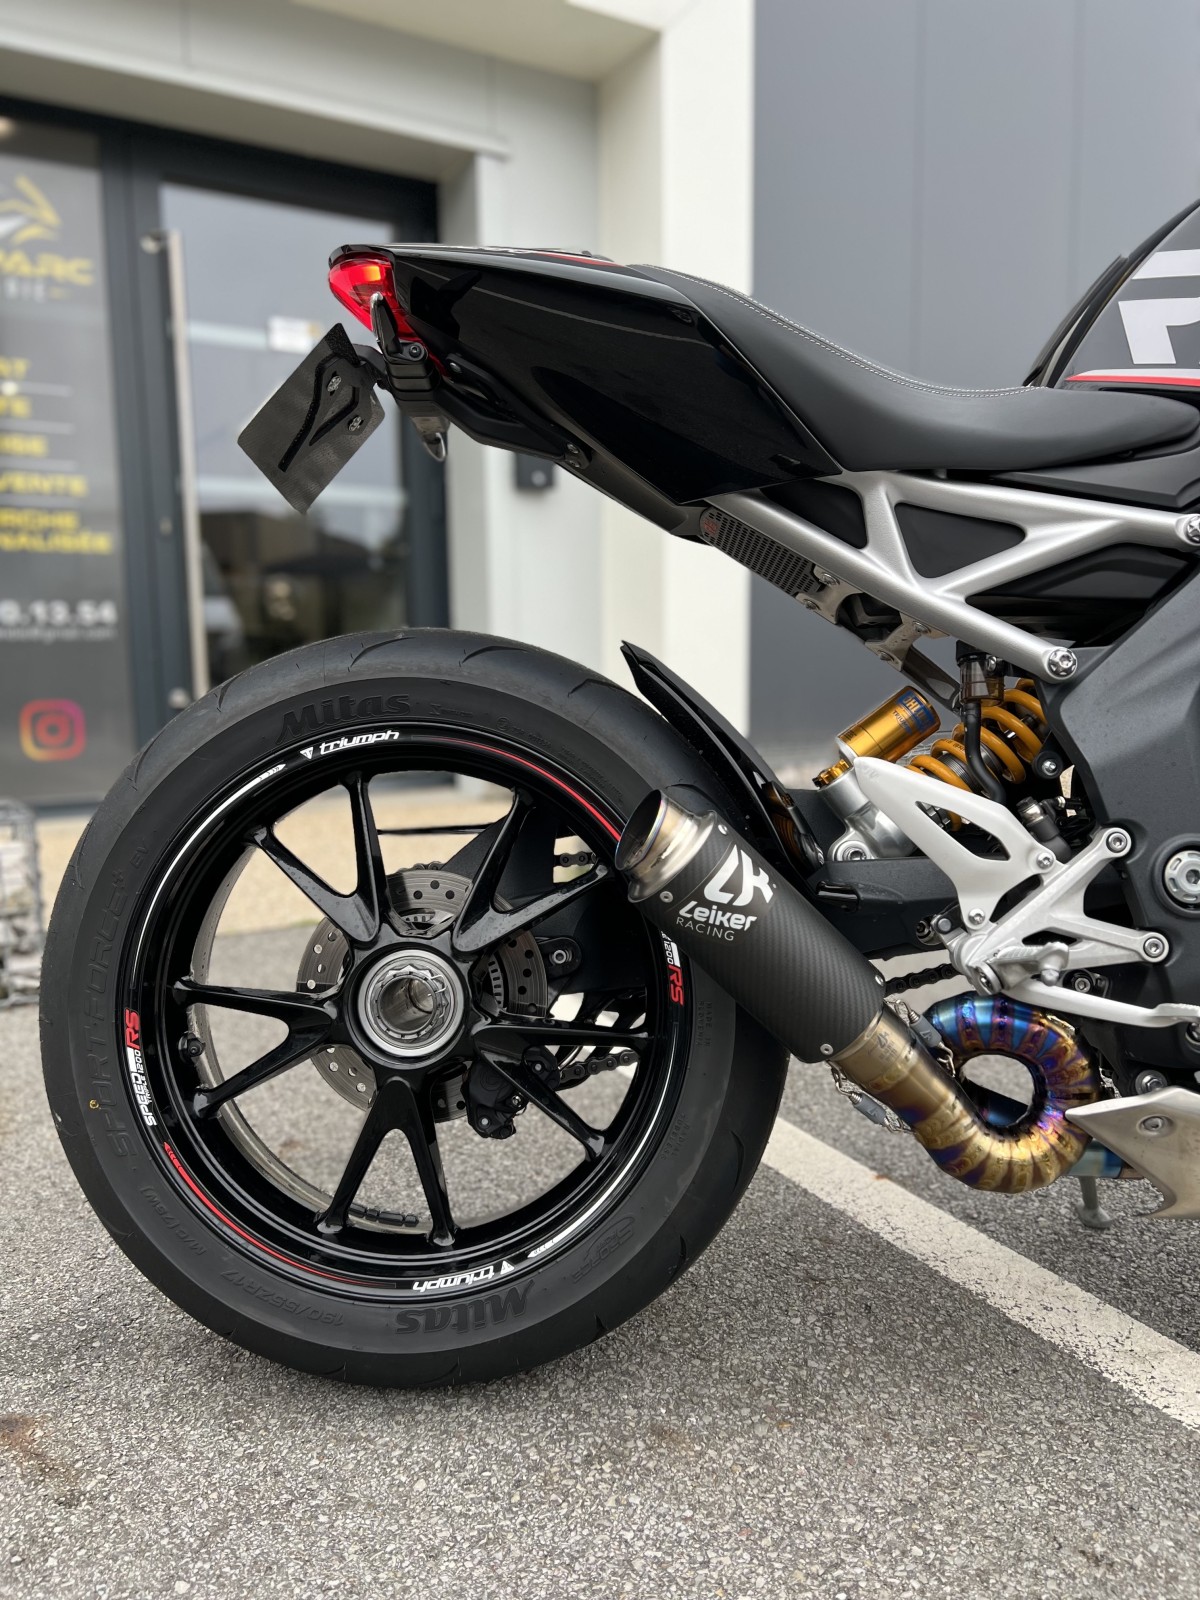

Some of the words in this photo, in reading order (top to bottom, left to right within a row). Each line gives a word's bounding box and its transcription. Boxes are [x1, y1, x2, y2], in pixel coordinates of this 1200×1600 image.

[275, 694, 411, 745] Mitas
[319, 730, 400, 755] triumph
[676, 916, 736, 942] RACING
[678, 900, 758, 931] Leiker
[668, 964, 685, 1006] RS
[125, 1007, 141, 1050] RS
[134, 1049, 145, 1074] 1200
[131, 1072, 157, 1126] SPEED
[412, 1264, 495, 1293] triumph
[396, 1279, 536, 1335] Mitas
